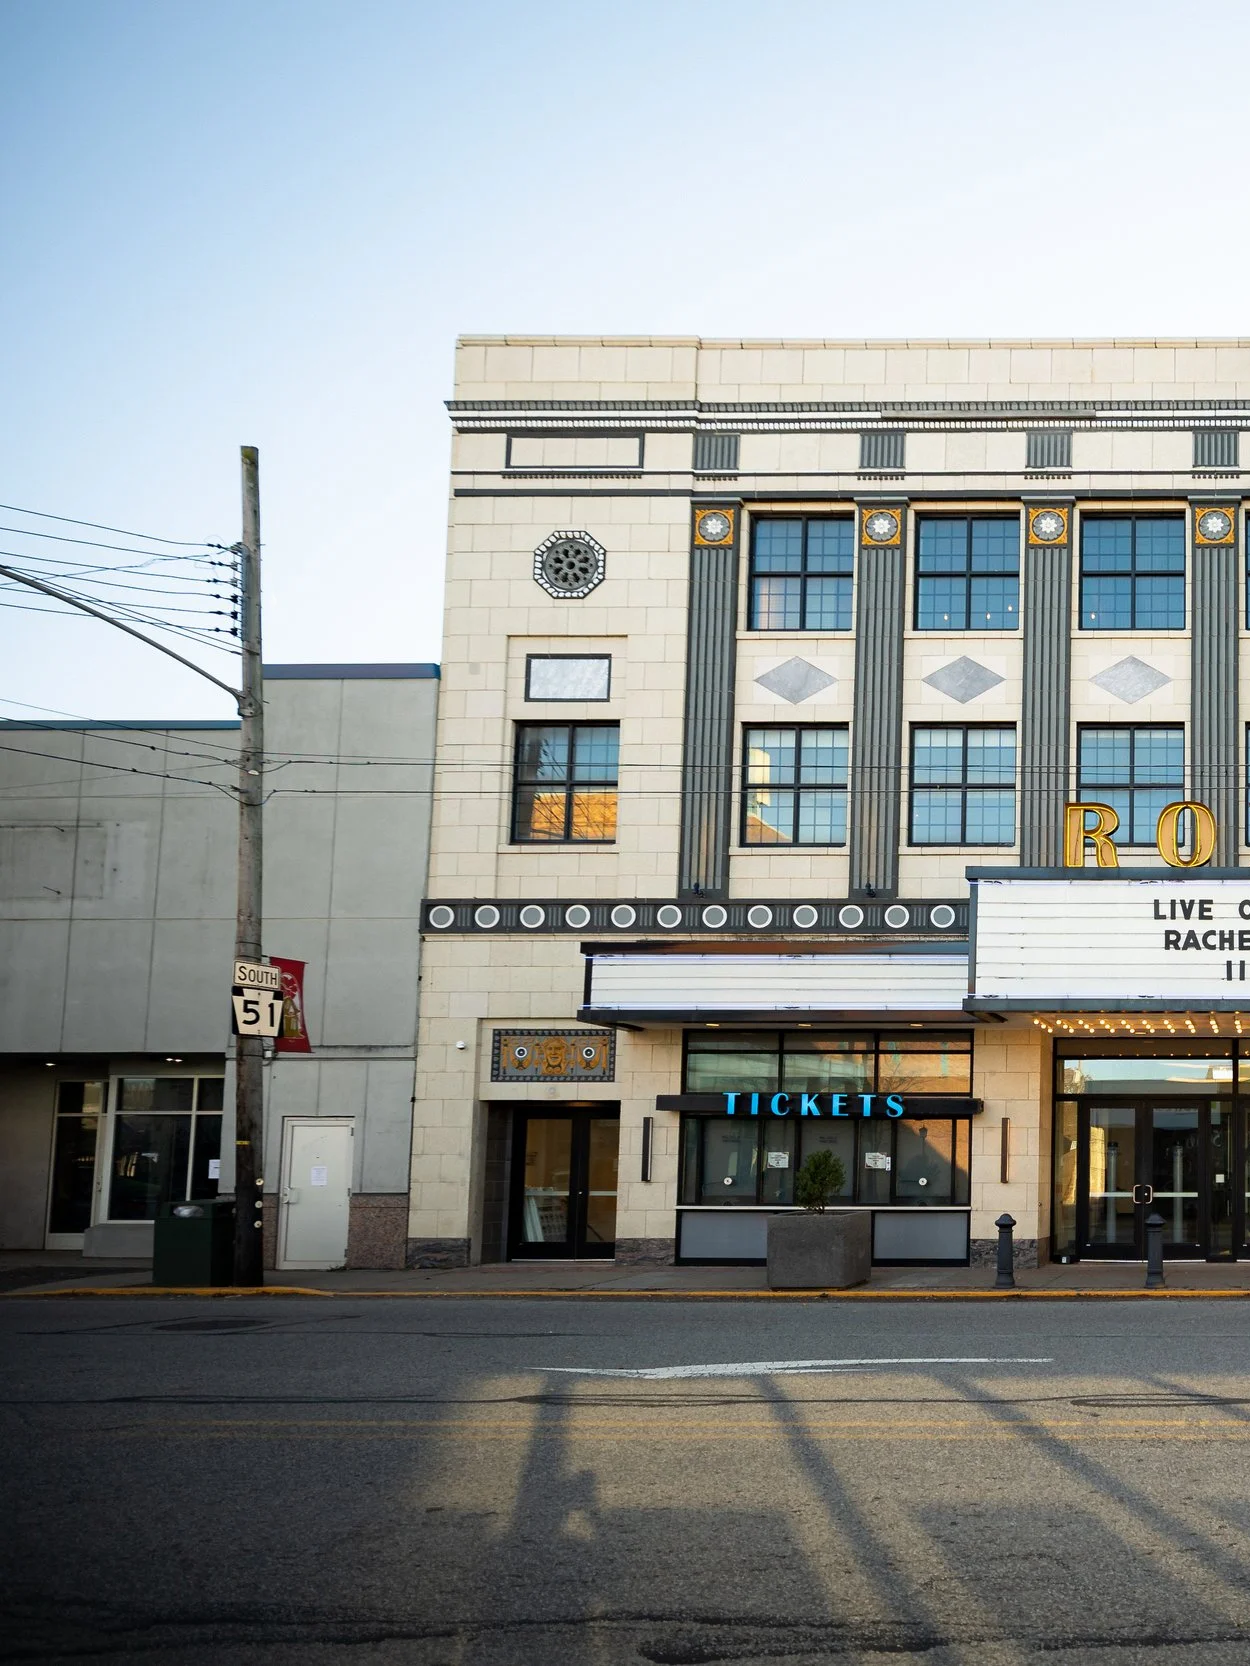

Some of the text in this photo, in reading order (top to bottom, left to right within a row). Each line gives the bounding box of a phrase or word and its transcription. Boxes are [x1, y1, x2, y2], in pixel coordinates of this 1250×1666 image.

[1153, 899, 1214, 921] LIVE
[238, 965, 279, 986] SOUTH
[1226, 960, 1246, 981] 11
[242, 1000, 275, 1027] 51
[723, 1092, 904, 1117] TICKETS
